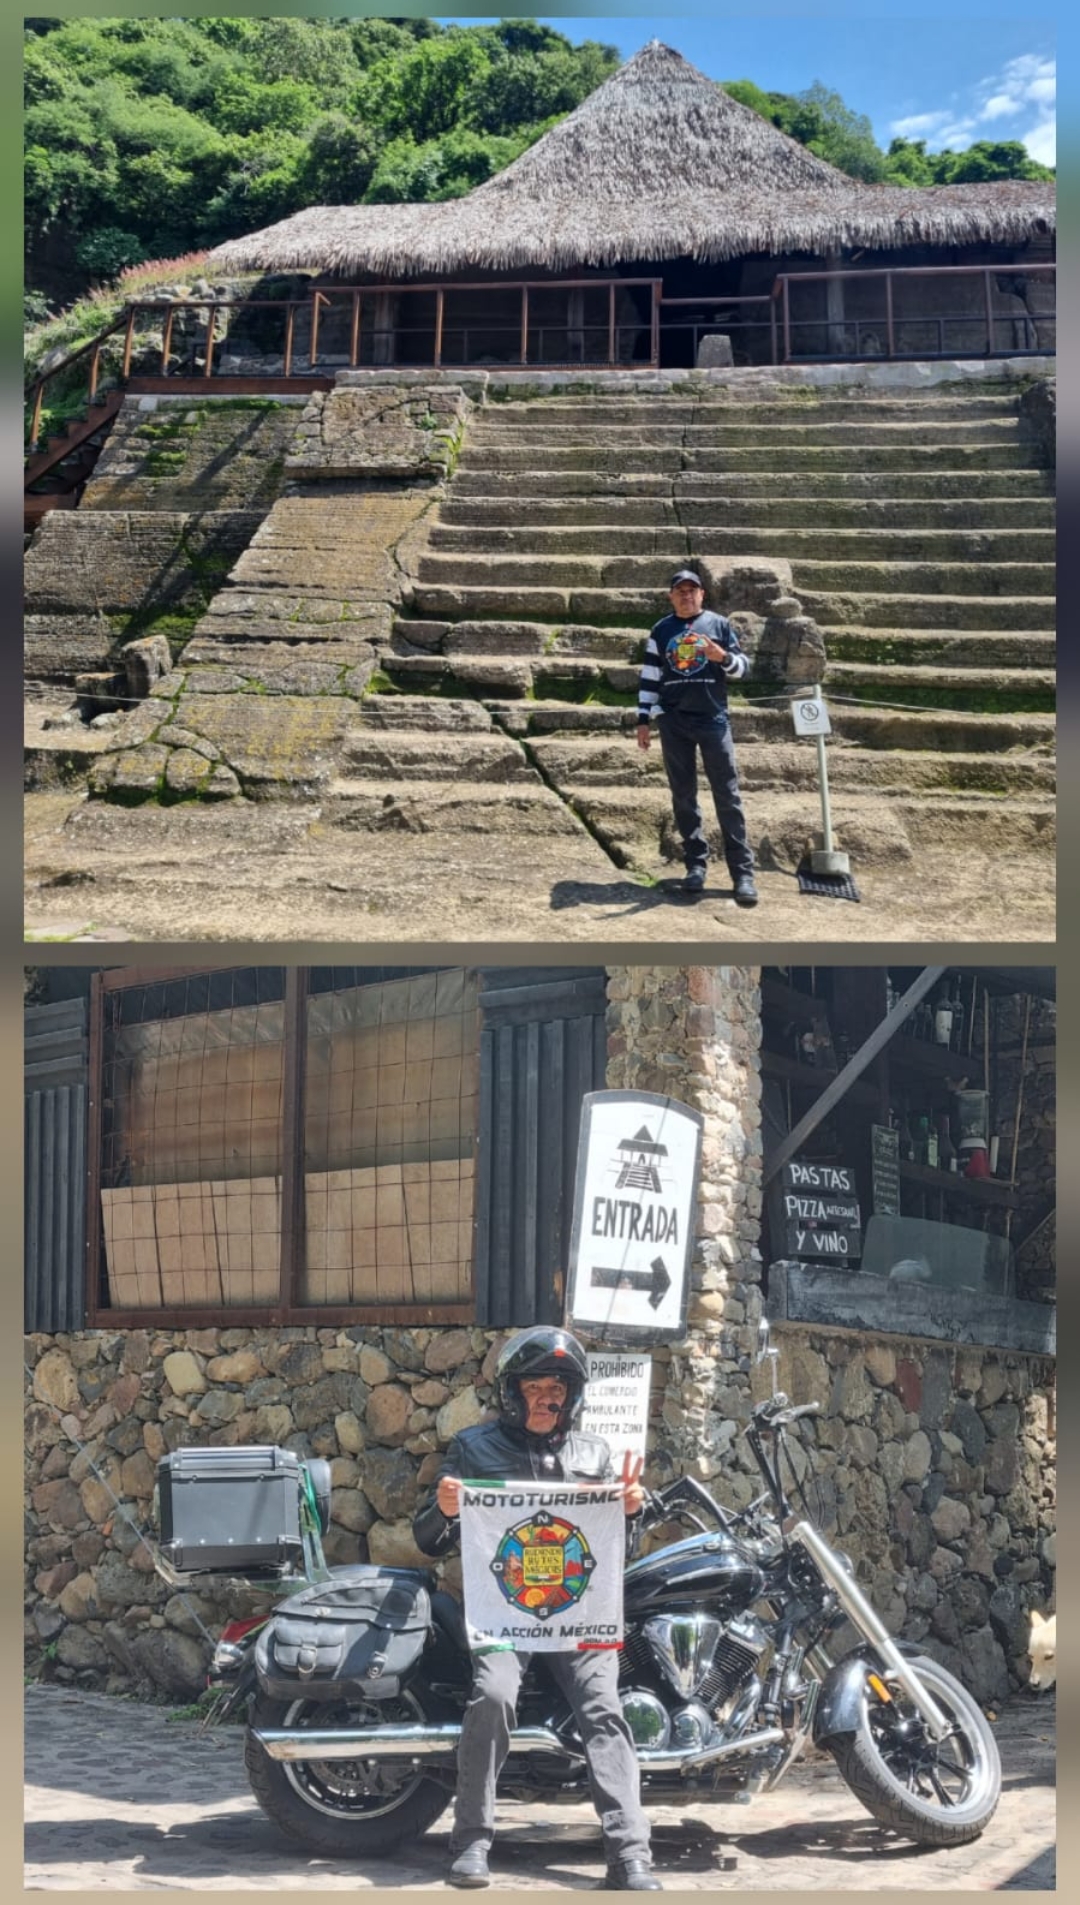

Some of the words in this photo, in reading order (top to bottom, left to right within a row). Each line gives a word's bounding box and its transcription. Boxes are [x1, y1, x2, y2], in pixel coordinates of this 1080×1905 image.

[789, 1163, 850, 1190] PASTAS
[785, 1195, 827, 1220] PIZZA
[592, 1196, 678, 1245] ENTRADA
[796, 1230, 806, 1250] Y
[813, 1230, 848, 1253] VINO
[590, 1361, 645, 1378] PROHIBIDO
[587, 1404, 638, 1416] AMBULANTE
[599, 1423, 620, 1434] ESTA
[621, 1423, 643, 1434] ZONA
[500, 1623, 553, 1638] ACCIÓN
[560, 1622, 618, 1637] MÉXICO
